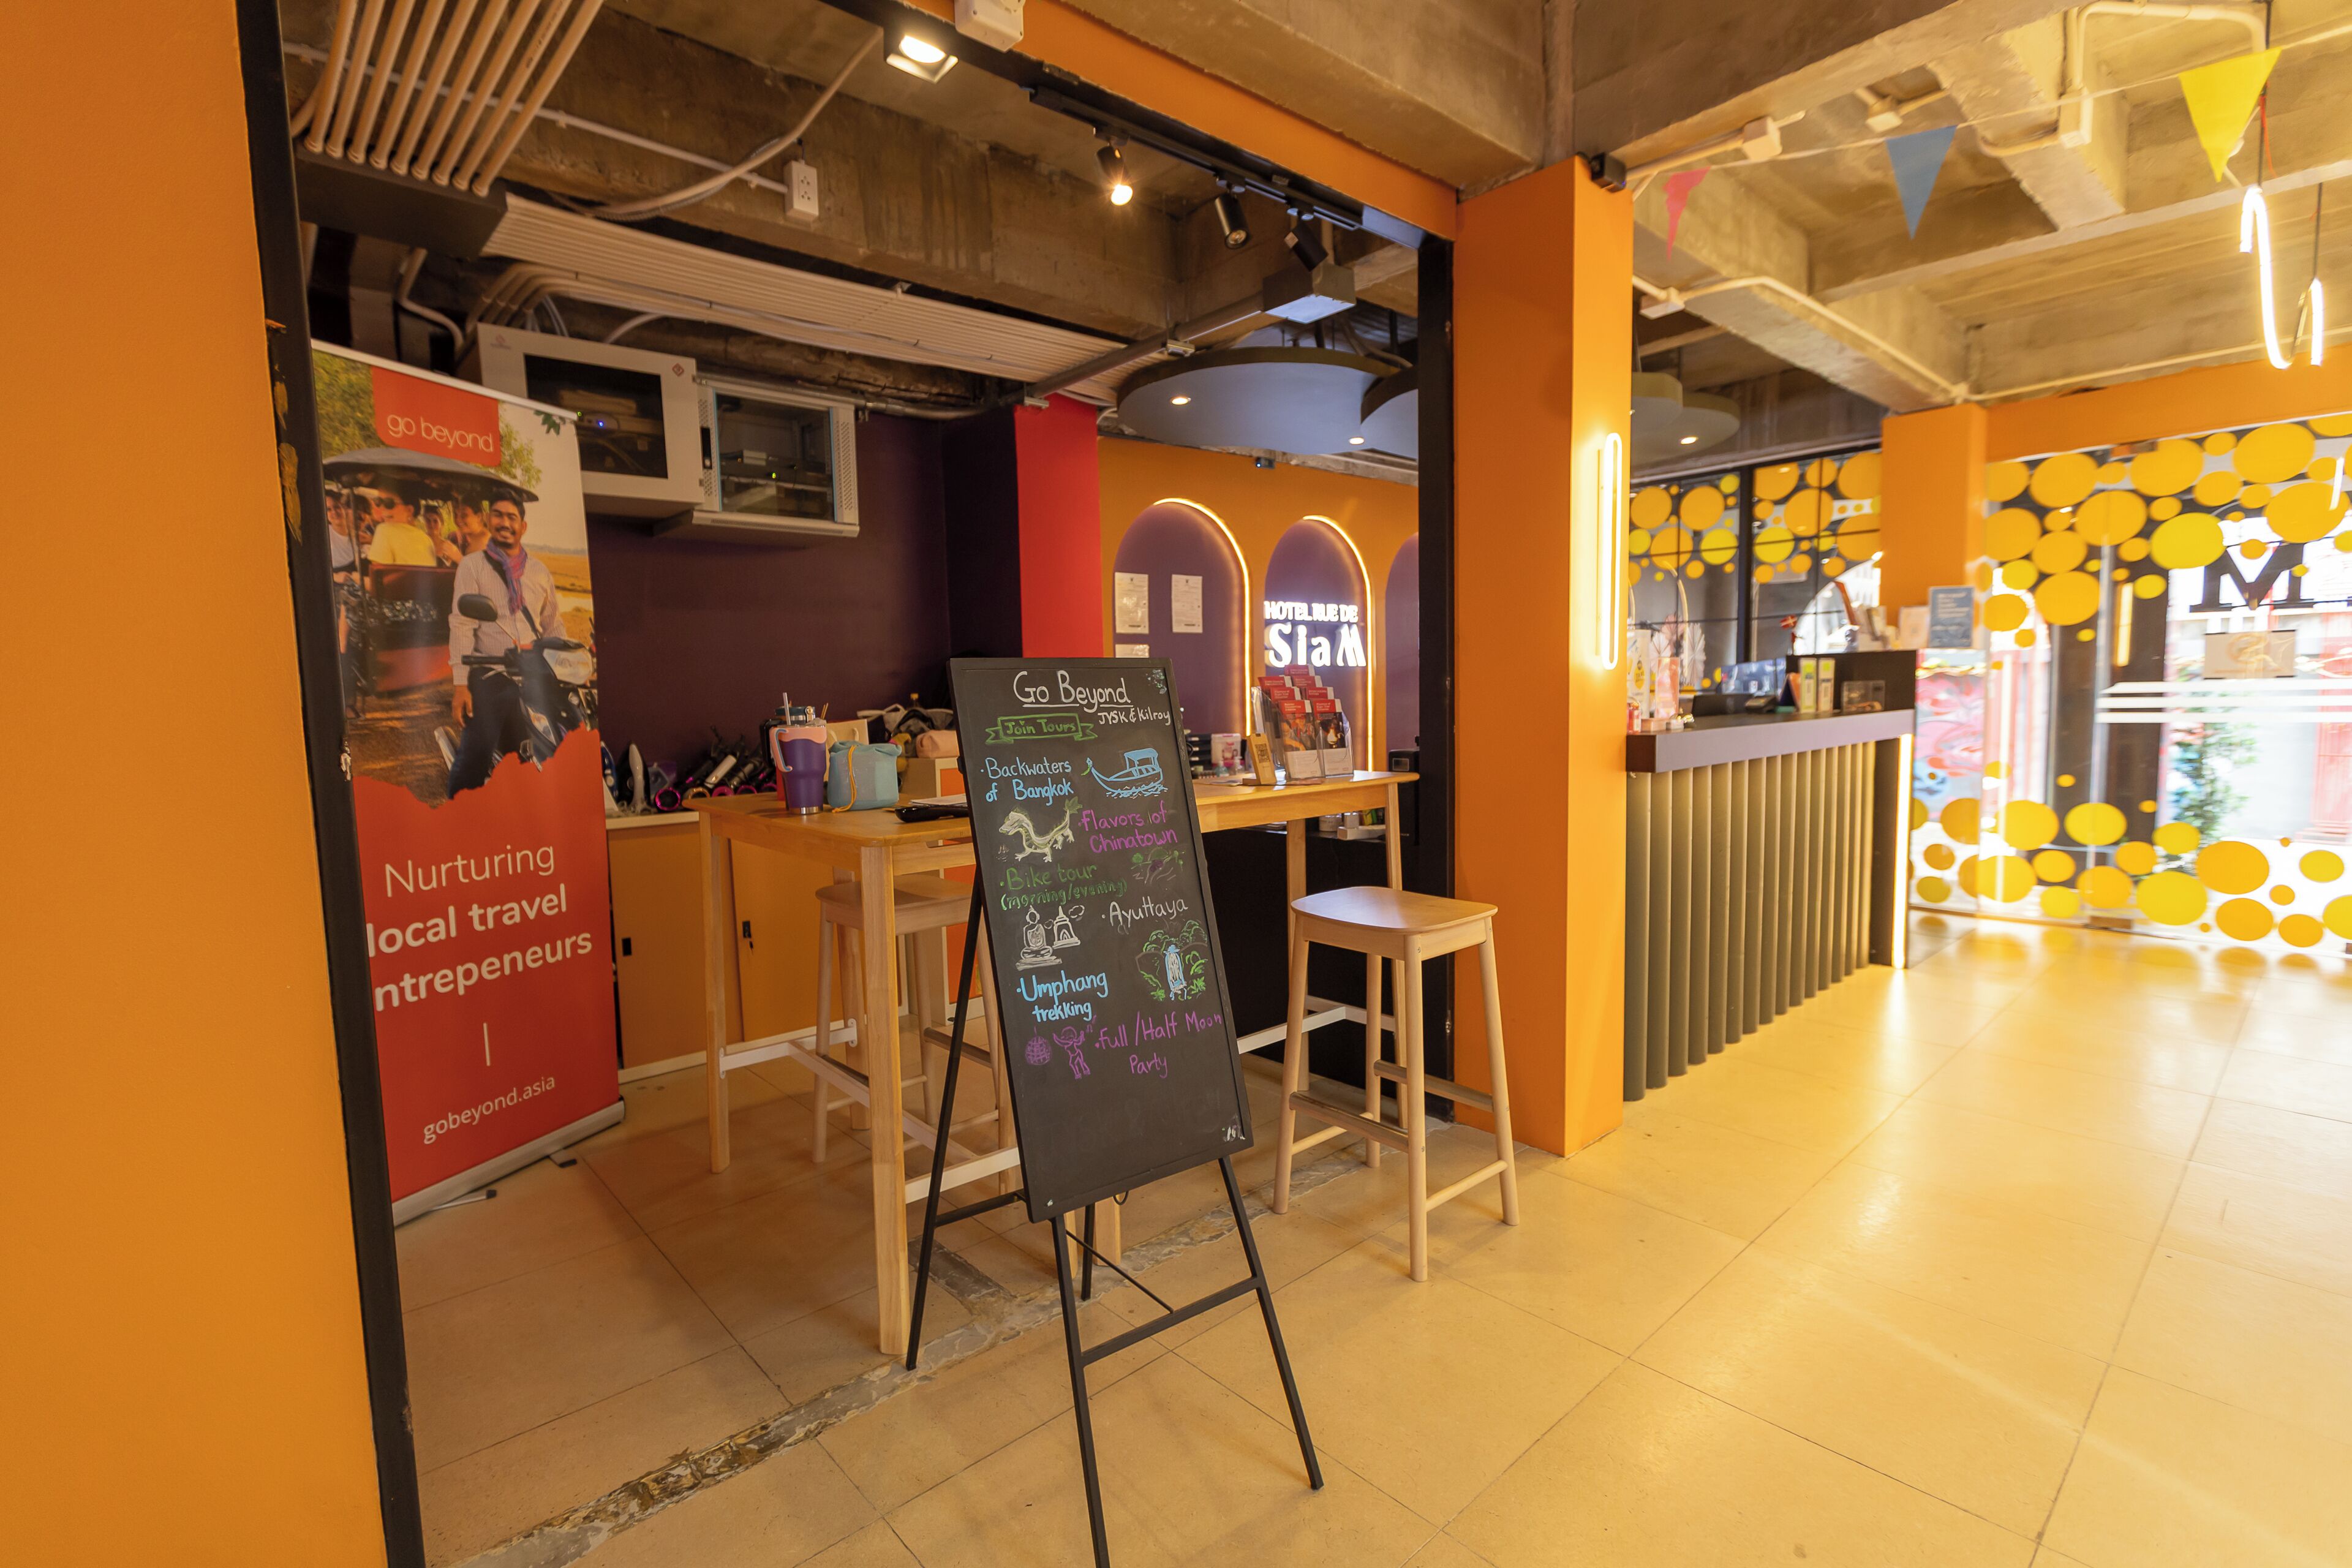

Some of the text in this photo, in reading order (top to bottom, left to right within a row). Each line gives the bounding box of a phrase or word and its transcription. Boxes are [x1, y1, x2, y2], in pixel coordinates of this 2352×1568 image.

[386, 414, 494, 453] go beyond
[1264, 601, 1359, 623] HOTEL RUE DE
[1013, 670, 1131, 713] Go Beyond
[1005, 719, 1076, 735] Join Tours
[1098, 710, 1128, 725] JYSK
[985, 756, 1072, 778] Backwaters
[986, 777, 1074, 806] of Bangkok
[1081, 800, 1167, 831] Flavors of
[1089, 829, 1178, 853] Chinatown
[385, 844, 556, 897] Nurturing
[1006, 863, 1097, 890] Bike tour
[366, 883, 567, 958] local travel
[1110, 896, 1189, 929] Ayuttaya
[374, 931, 593, 1012] ntrepeneurs
[1020, 970, 1109, 1006] Umphang
[1032, 1001, 1092, 1022] trekking
[1099, 1024, 1128, 1049] Full
[1185, 1011, 1222, 1032] Moon
[1129, 1052, 1167, 1079] Party
[423, 1076, 556, 1145] gobeyond.asia
